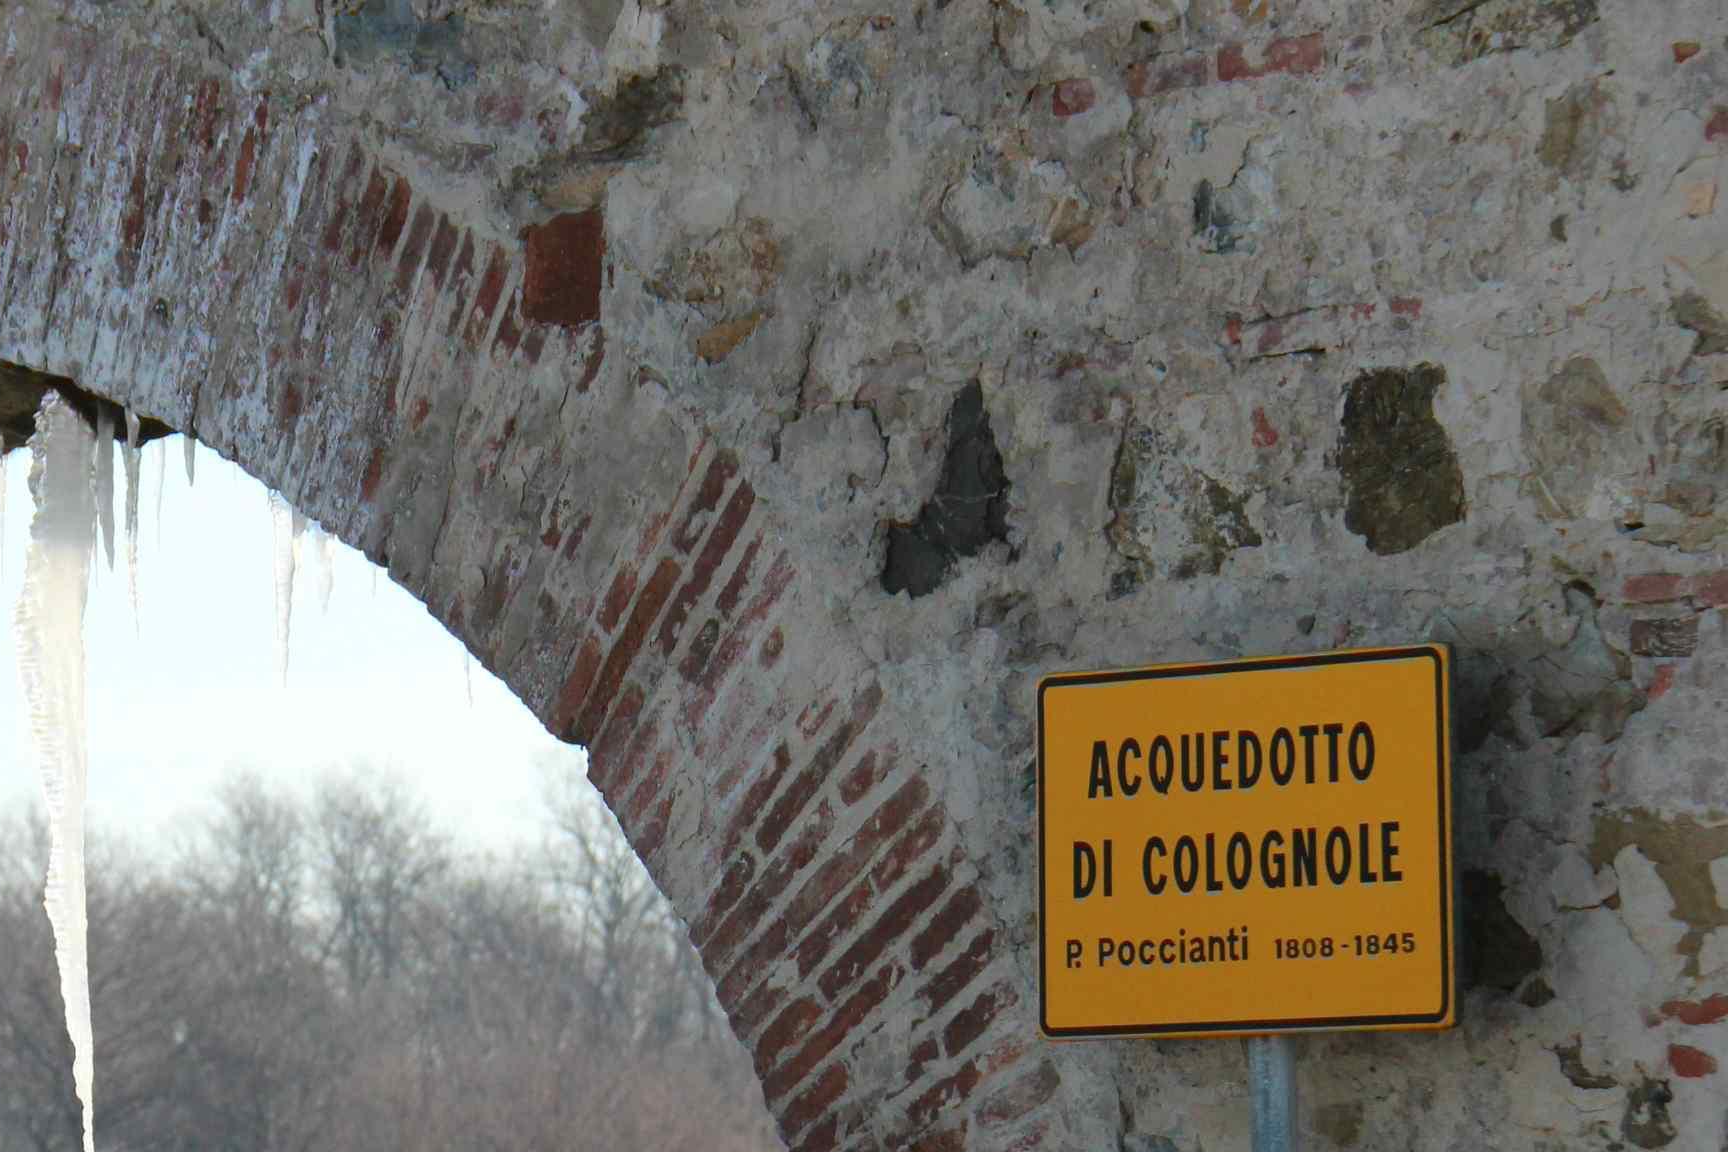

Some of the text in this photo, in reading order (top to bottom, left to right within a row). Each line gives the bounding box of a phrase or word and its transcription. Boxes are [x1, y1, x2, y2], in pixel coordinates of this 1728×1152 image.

[1087, 720, 1376, 799] ACQUEDOTTO
[1072, 821, 1403, 900] DI COLOGNOLE
[1065, 938, 1083, 969] P.
[1098, 925, 1249, 967] Poccianti
